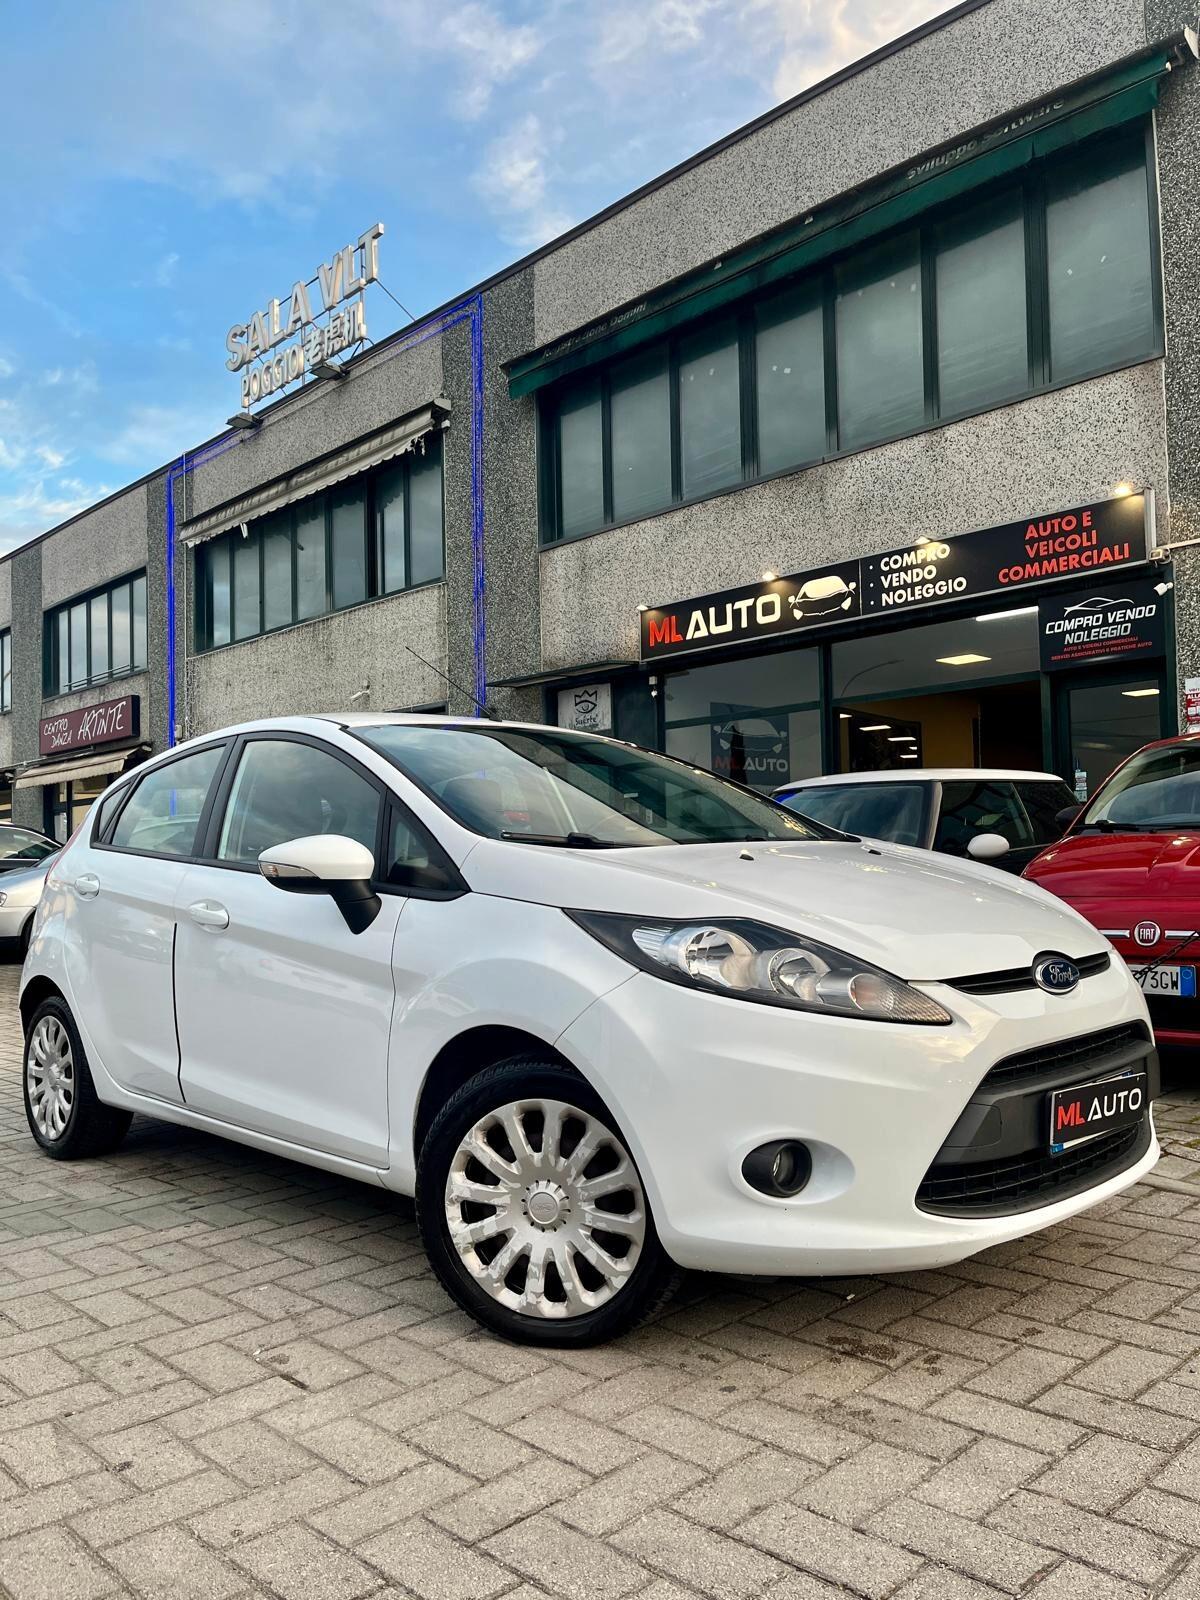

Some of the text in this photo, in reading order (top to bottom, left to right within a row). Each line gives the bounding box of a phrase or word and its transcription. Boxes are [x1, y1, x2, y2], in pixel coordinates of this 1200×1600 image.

[907, 139, 977, 180] Sviluppo
[225, 222, 384, 372] SALA VLT
[304, 301, 367, 366] 老虎机
[241, 343, 304, 408] POGGIO
[1025, 511, 1092, 540] AUTO E
[880, 543, 951, 571] COMPRO
[1025, 529, 1097, 558] VEICOLI
[880, 565, 937, 588] VENDO
[998, 542, 1130, 583] COMMERCIALI
[881, 576, 967, 606] NOLEGGIO
[649, 592, 781, 647] ML AUTO
[1045, 604, 1156, 634] COMPRO VENDO
[1064, 622, 1132, 645] NOLEGGIO
[44, 718, 69, 736] CENTRO
[51, 729, 73, 749] DANZA
[743, 757, 789, 772] AUTO
[1140, 928, 1155, 940] FIAT
[1049, 964, 1075, 984] Ford
[1057, 1087, 1142, 1130] ML AUTO
